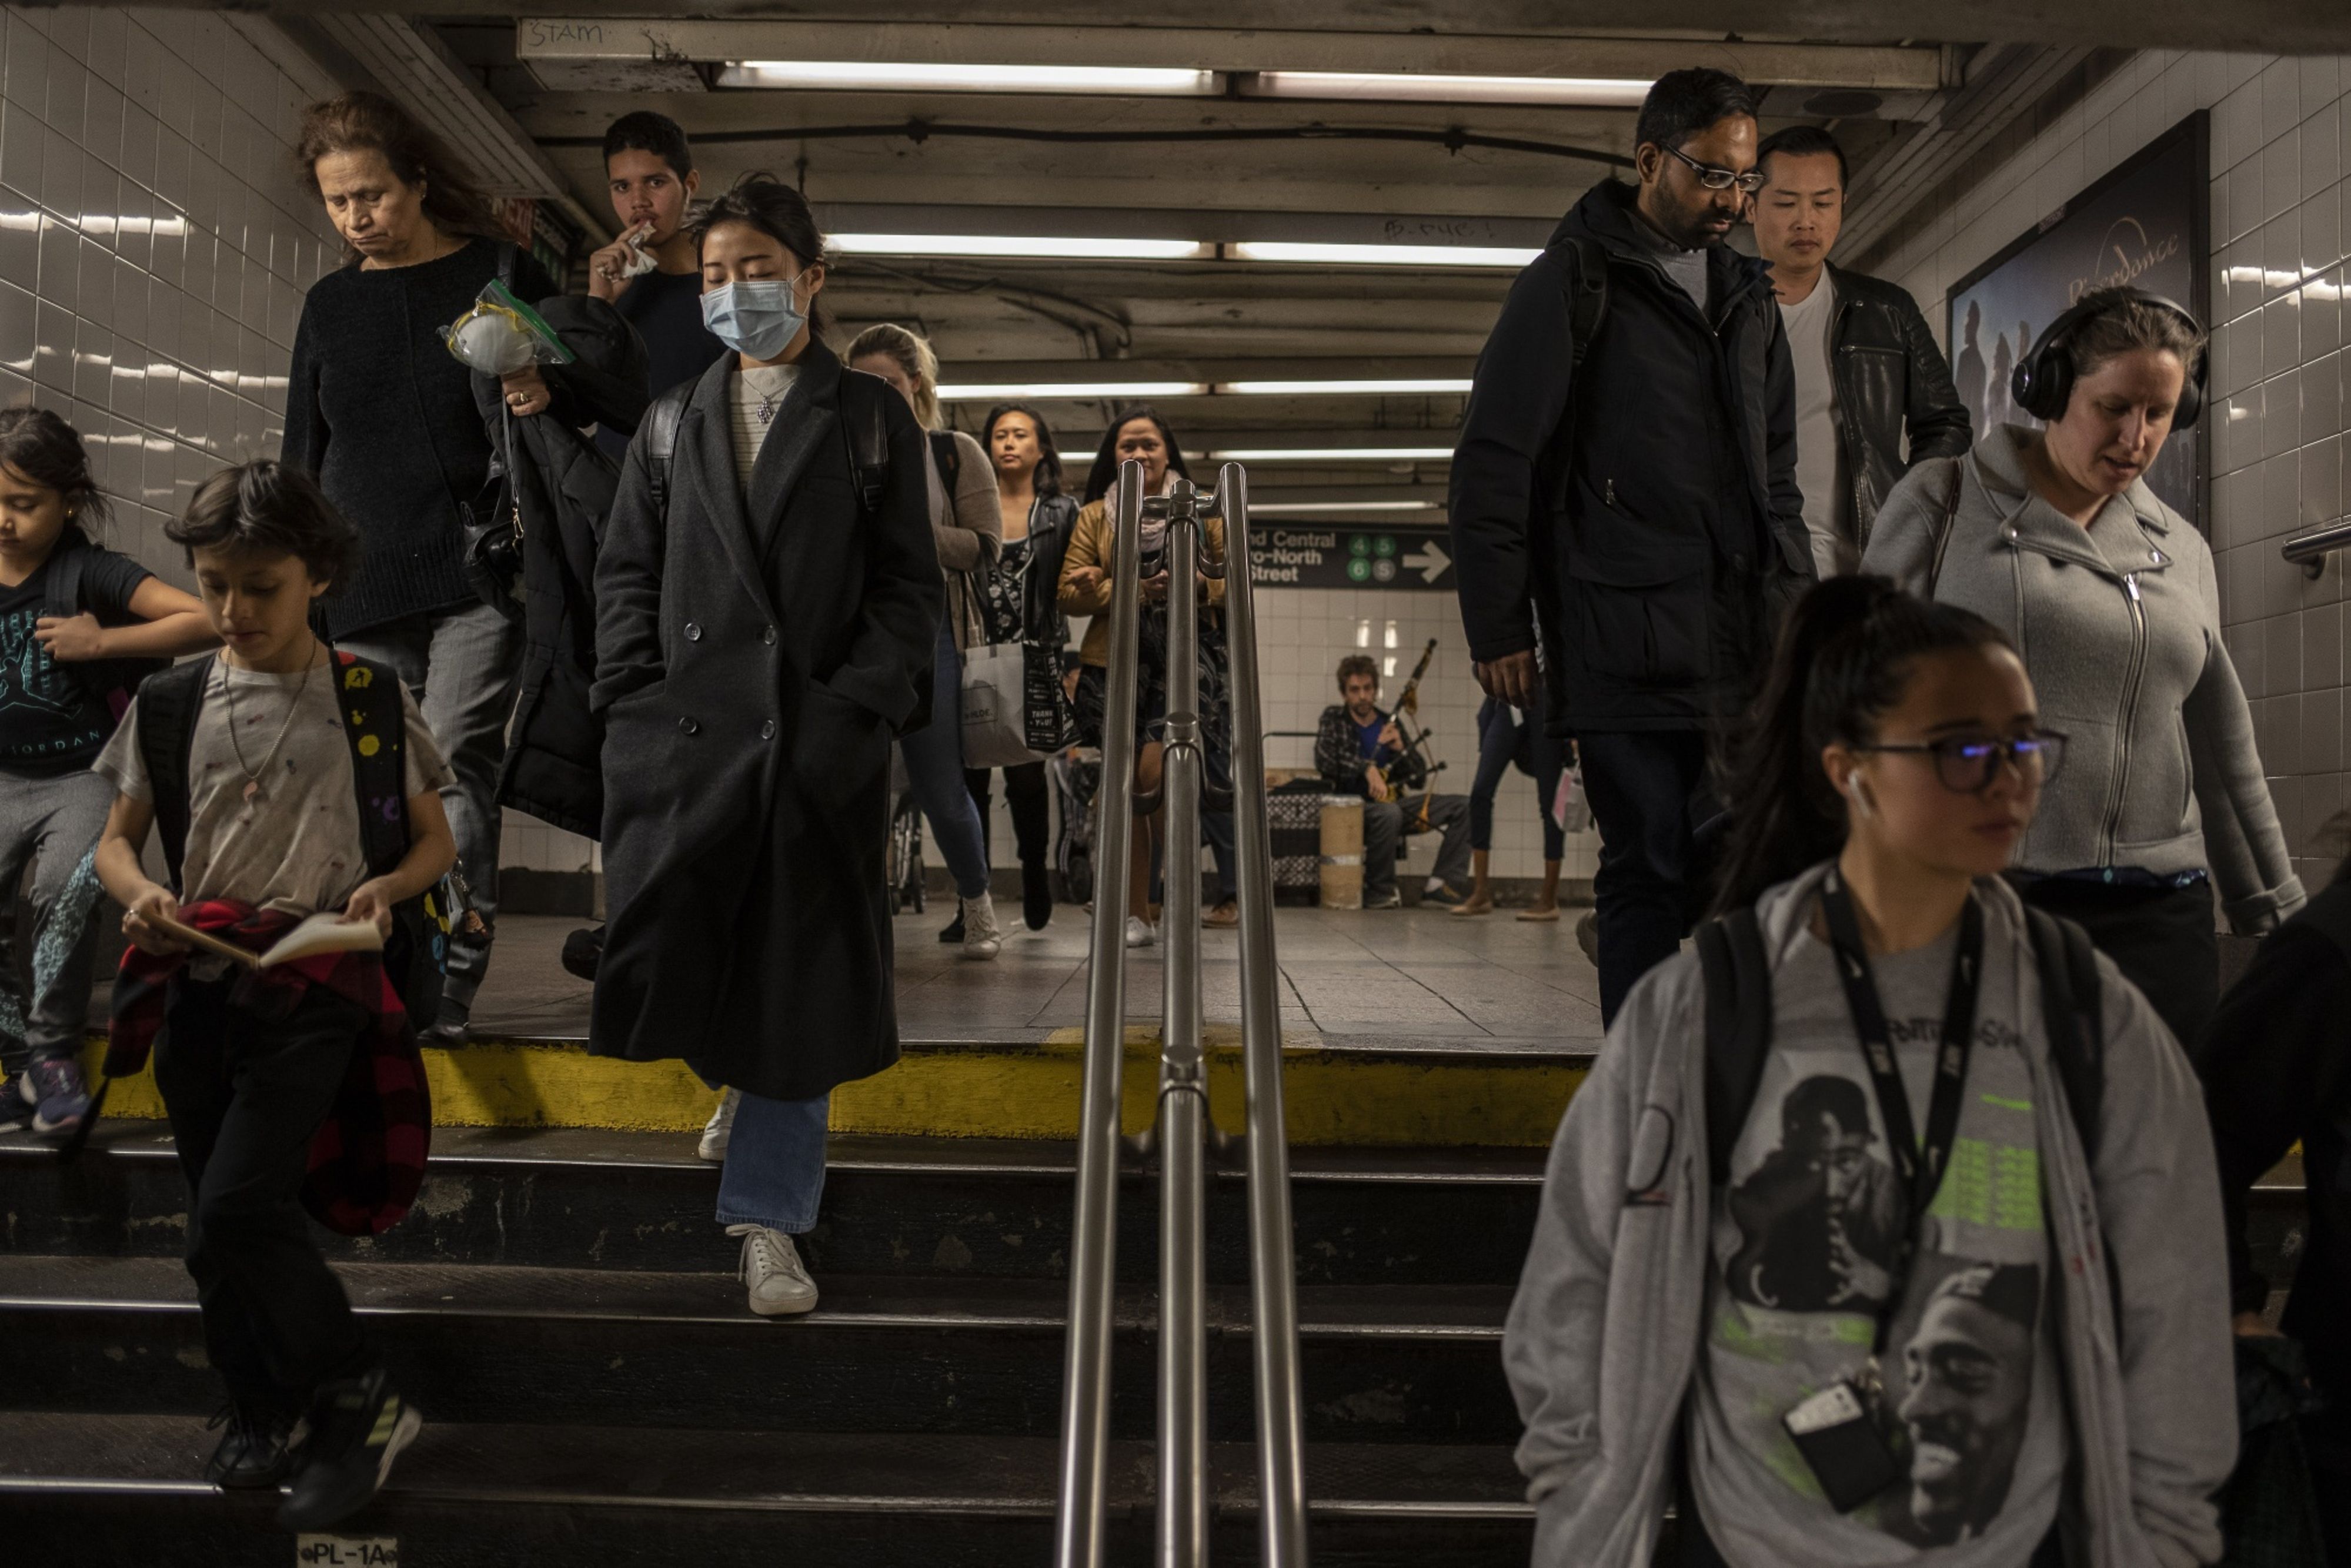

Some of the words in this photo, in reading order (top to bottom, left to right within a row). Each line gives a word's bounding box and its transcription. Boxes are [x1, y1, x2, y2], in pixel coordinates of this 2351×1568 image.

[1273, 530, 1336, 548] Central
[1354, 537, 1364, 551] 4
[1379, 538, 1390, 552] 5
[1353, 561, 1364, 576] 6
[313, 1543, 387, 1565] PL-1A
